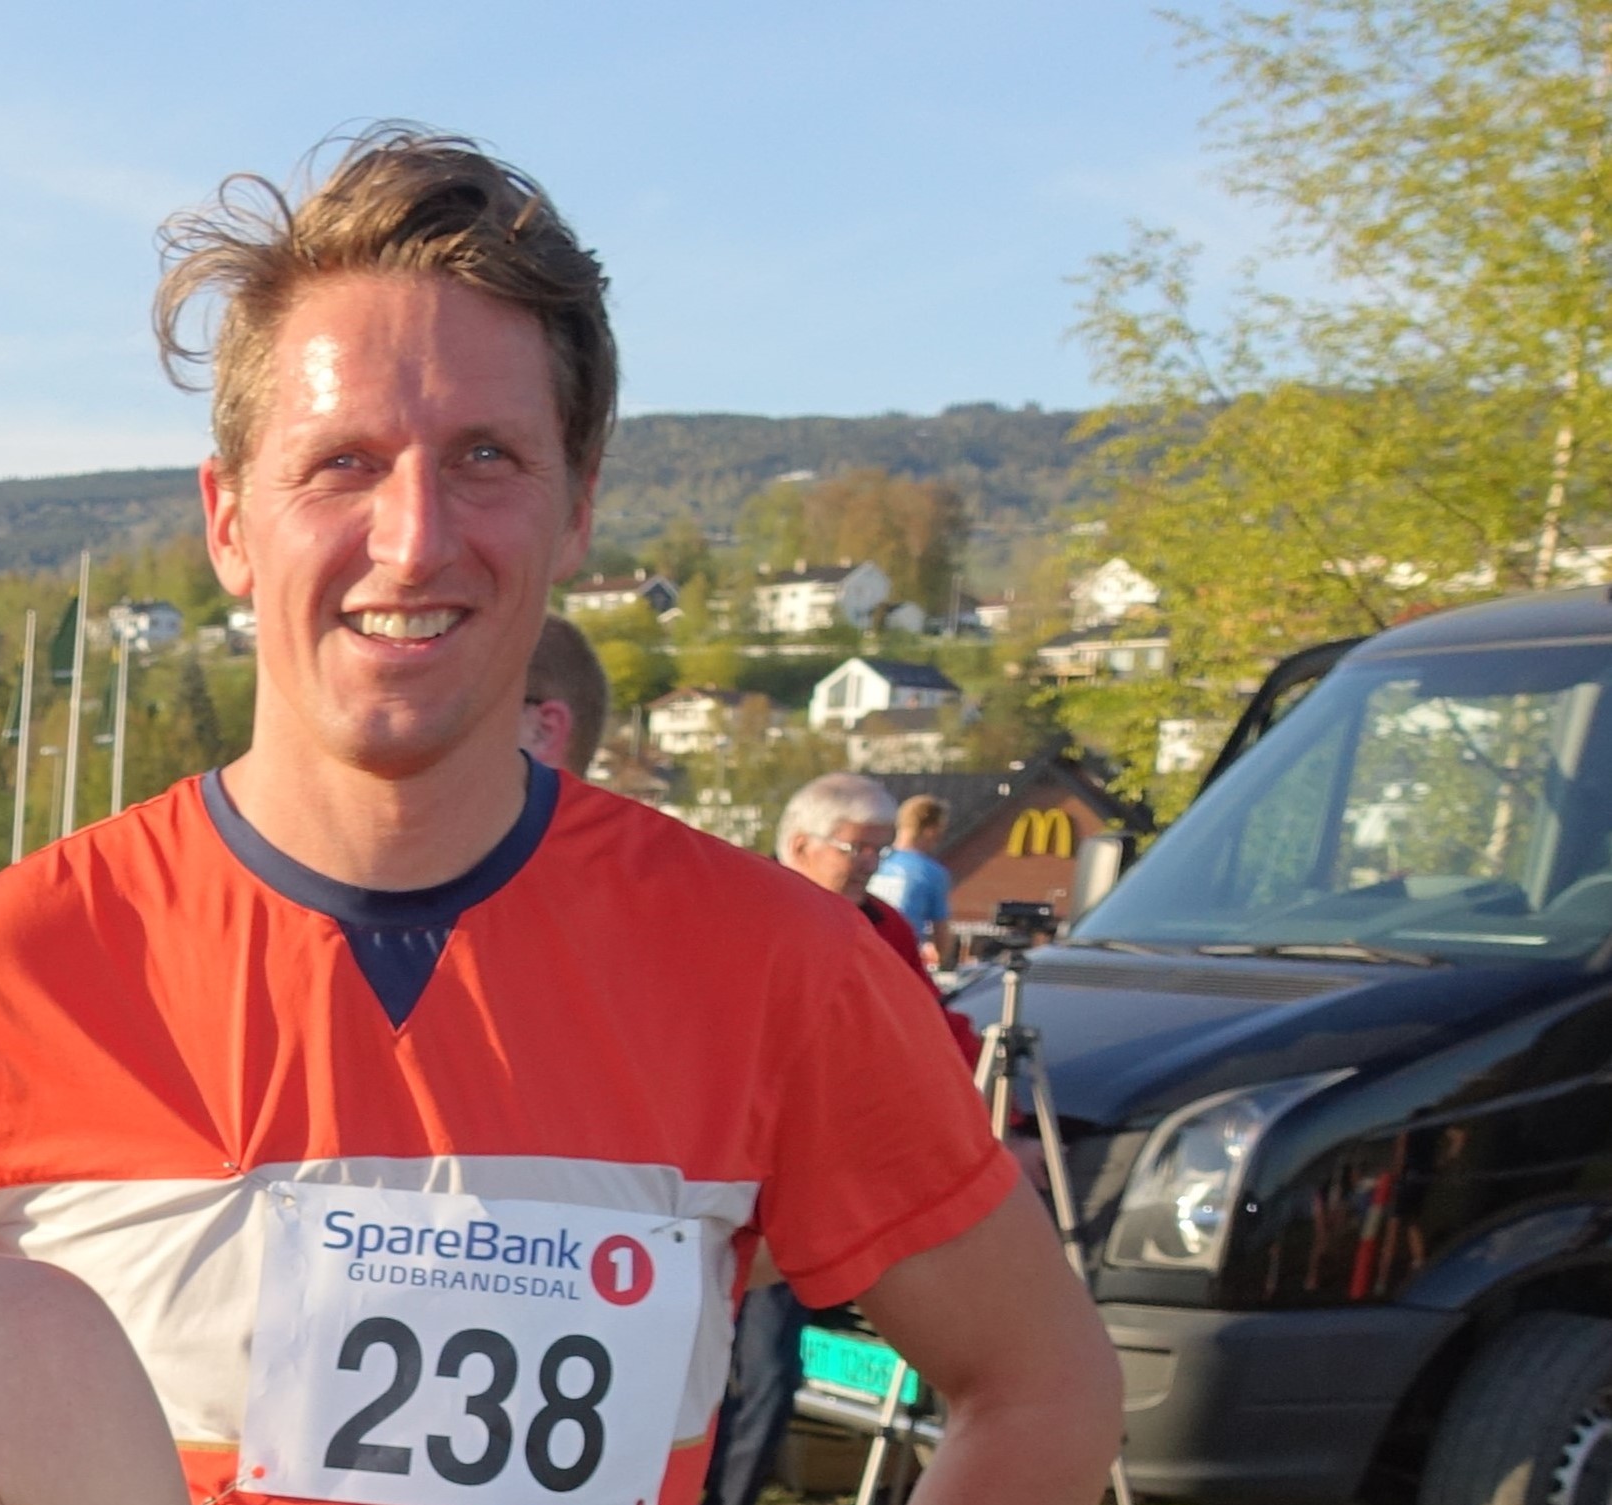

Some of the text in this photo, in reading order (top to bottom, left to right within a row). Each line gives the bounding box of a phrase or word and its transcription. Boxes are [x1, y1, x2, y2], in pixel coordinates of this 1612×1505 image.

[322, 1210, 584, 1270] SpareBank
[347, 1262, 582, 1301] GUDBRANDSDAL
[323, 1316, 613, 1493] 238
